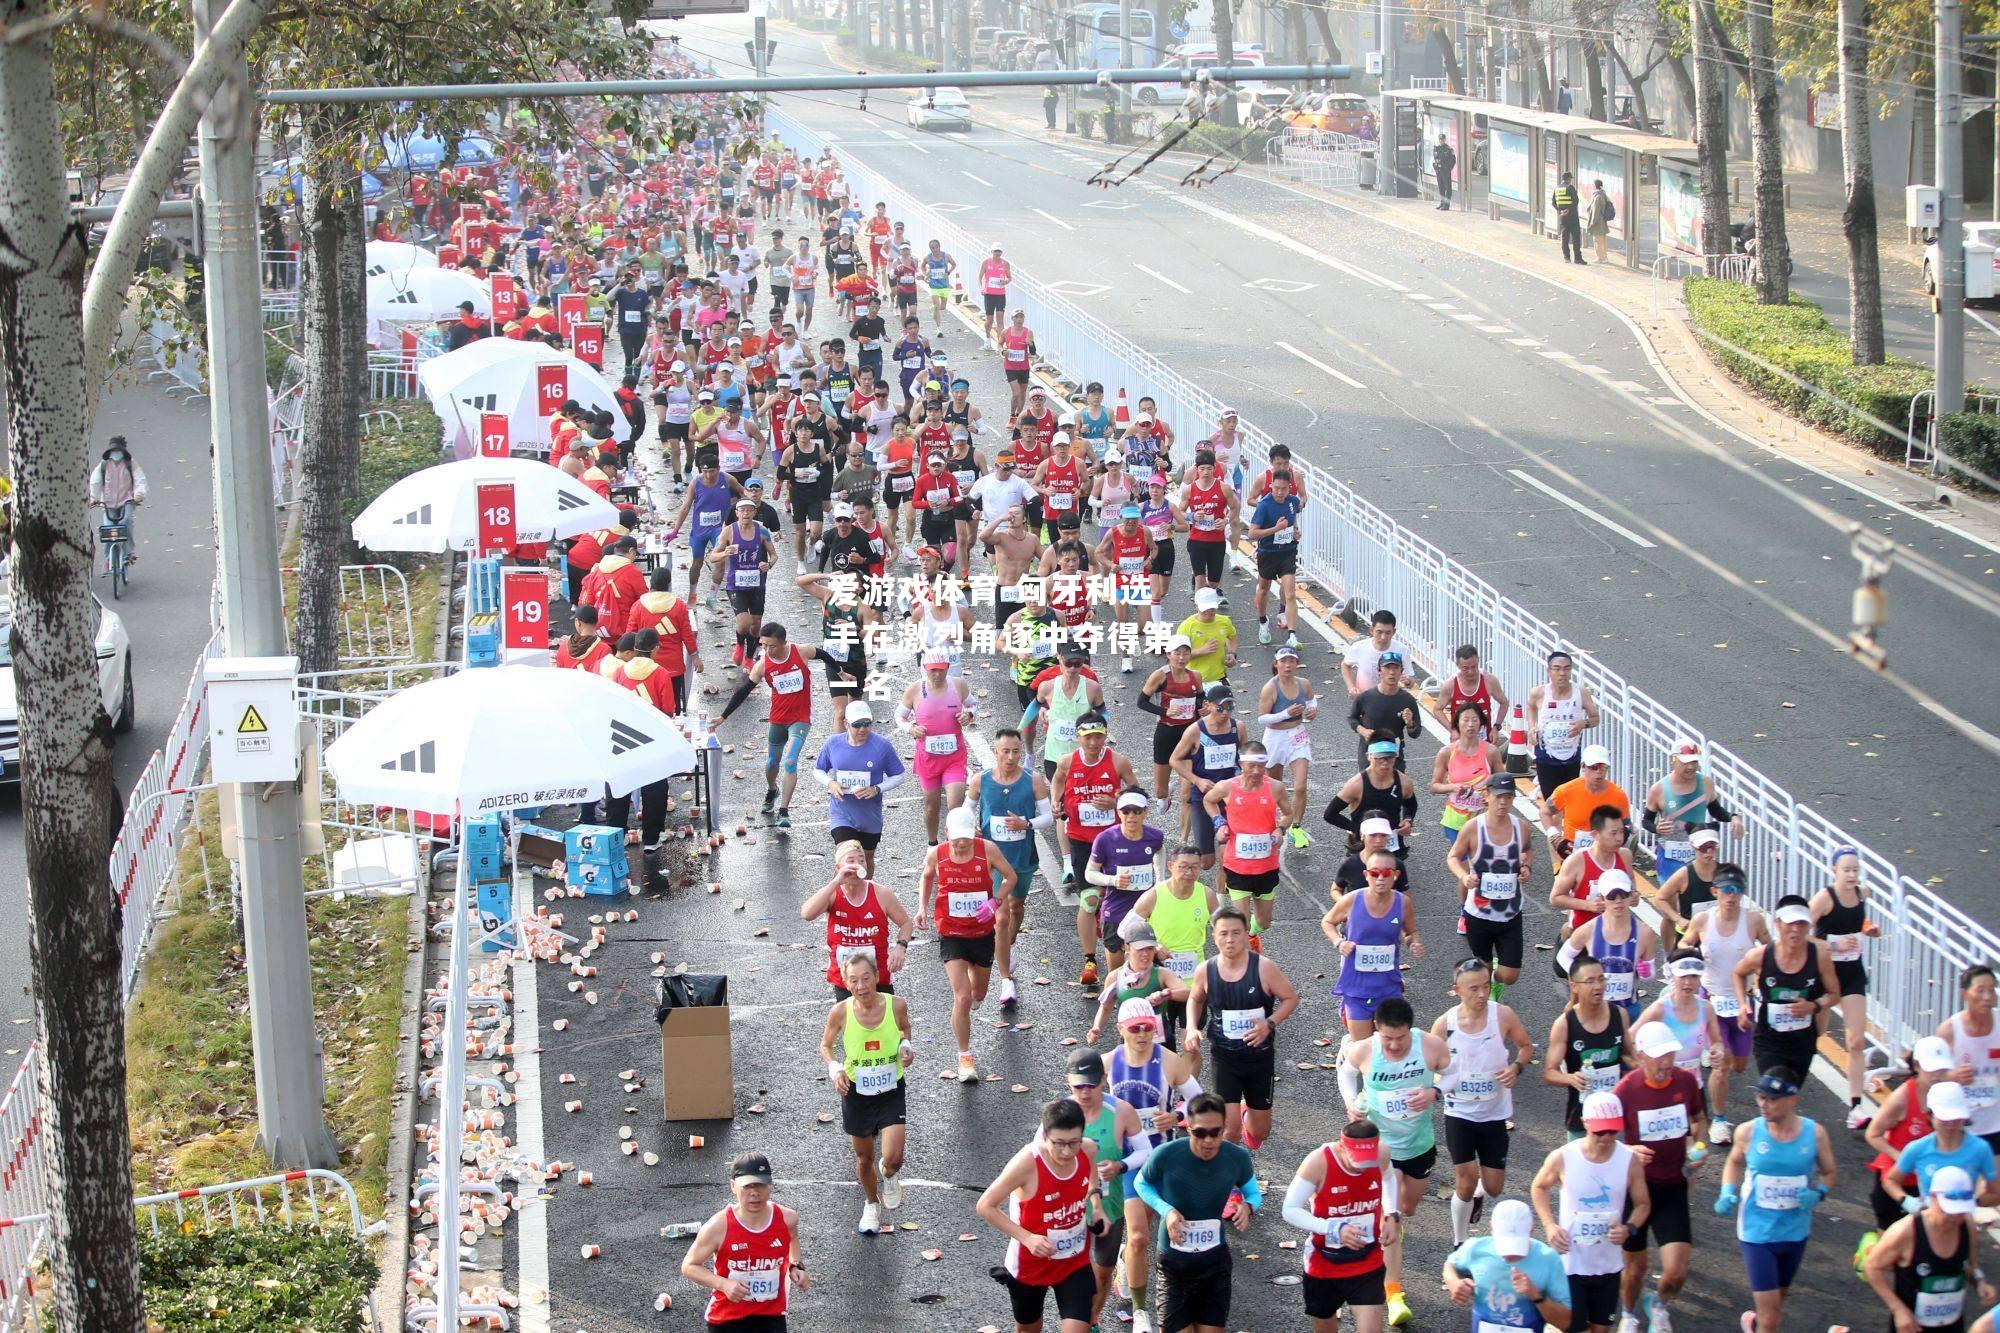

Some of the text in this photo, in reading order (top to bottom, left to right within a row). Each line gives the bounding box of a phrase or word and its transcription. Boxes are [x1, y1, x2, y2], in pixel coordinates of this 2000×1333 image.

[468, 238, 483, 249] 11
[495, 291, 511, 303] 13
[563, 311, 582, 324] 14
[578, 340, 599, 354] 15
[542, 383, 564, 399] 16
[484, 434, 505, 451] 17
[483, 507, 511, 526] 18
[511, 600, 543, 623] 19
[1059, 726, 1075, 737] B25
[1551, 728, 1568, 738] B24
[239, 740, 268, 748] 当心触电
[930, 740, 954, 752] B1873
[1210, 752, 1233, 763] B3097
[1074, 784, 1114, 795] BEIJING
[478, 792, 529, 810] ADIZERO
[1084, 810, 1110, 820] D1451
[479, 827, 487, 835] G
[581, 836, 593, 849] G
[1241, 842, 1268, 852] B4135
[481, 857, 488, 865] G
[585, 872, 594, 882] G
[1130, 873, 1150, 883] 0710
[834, 924, 879, 938] BEIJING
[1361, 954, 1390, 965] B3180
[1605, 983, 1628, 993] 0748
[862, 1073, 896, 1088] B0357
[1592, 1076, 1616, 1090] 3142
[1461, 1081, 1493, 1093] B3256
[1386, 1099, 1408, 1113] B05
[1647, 1116, 1682, 1133] C0078
[1043, 1198, 1087, 1222] BEIJIN
[1581, 1223, 1609, 1236] B20
[727, 1257, 784, 1271] BEIJING
